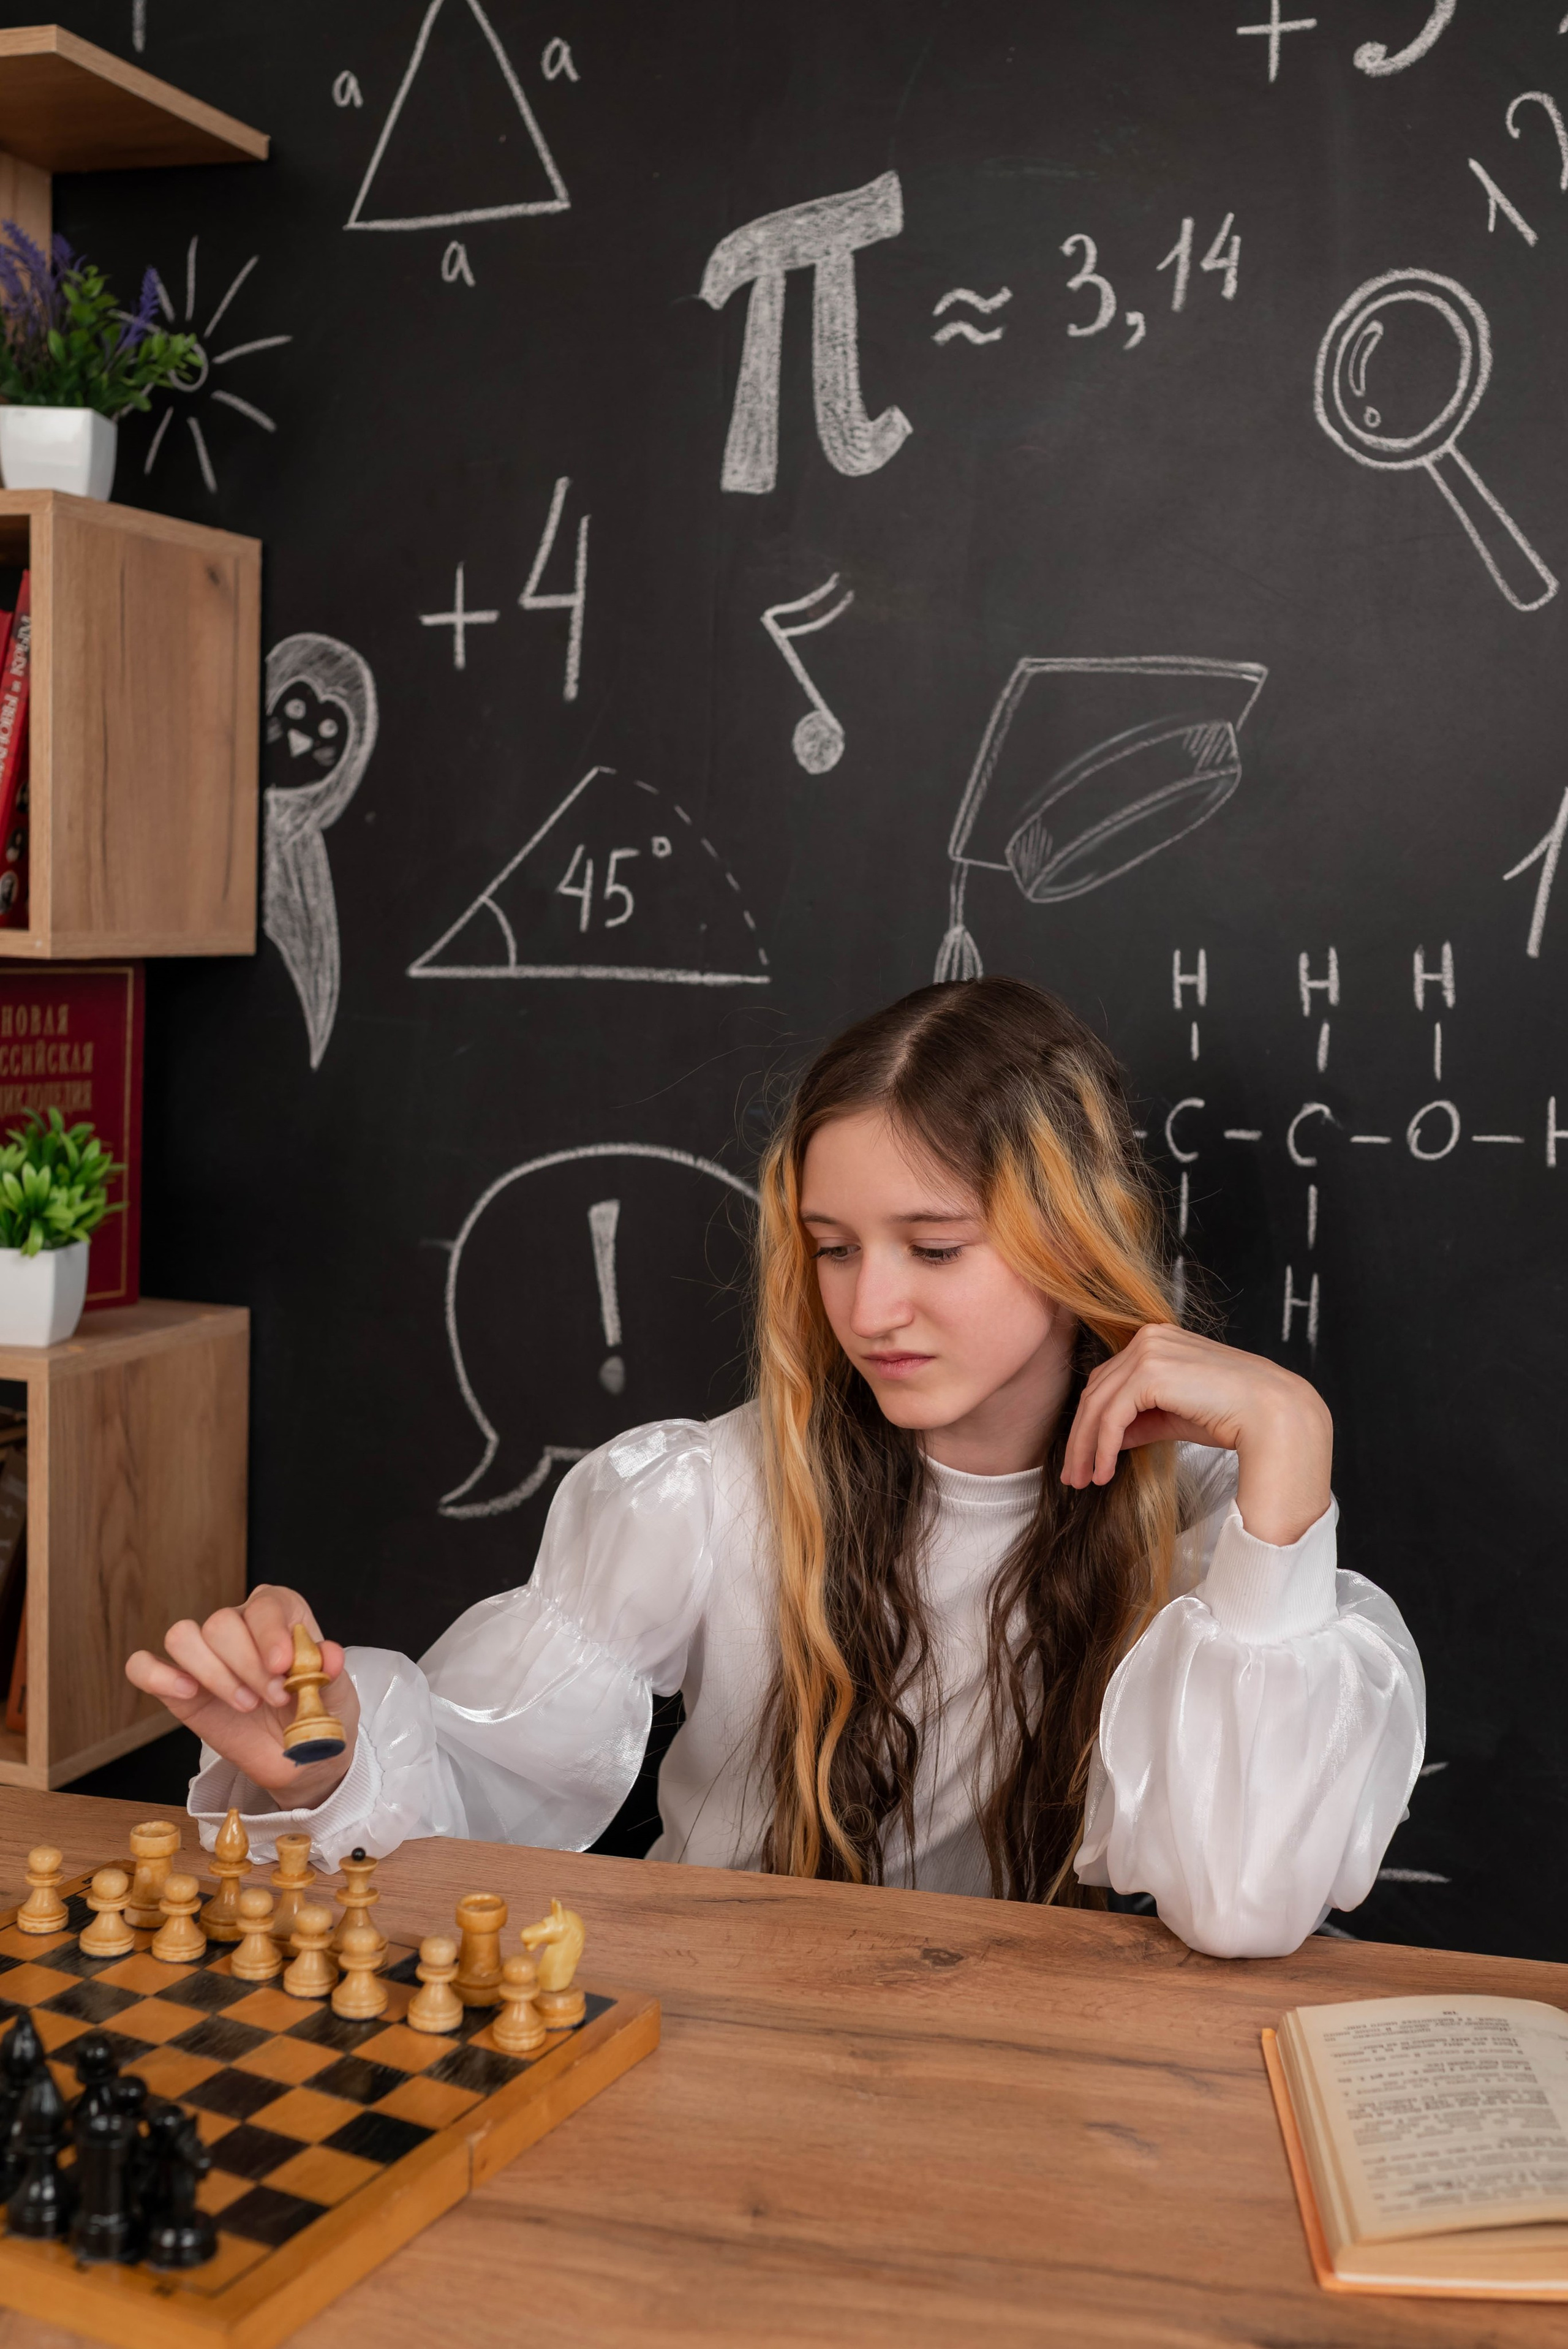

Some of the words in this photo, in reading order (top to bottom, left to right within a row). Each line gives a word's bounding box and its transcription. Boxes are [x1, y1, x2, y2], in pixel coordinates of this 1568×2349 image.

[333, 70, 363, 107] a
[541, 37, 579, 81] a
[441, 240, 475, 287] a
[1060, 212, 1242, 349] 3,14
[1173, 948, 1207, 1009] H
[1298, 947, 1340, 1017] H
[1412, 941, 1455, 1011] H
[1, 1003, 69, 1038] НОВАЯ
[1282, 1264, 1319, 1344] H
